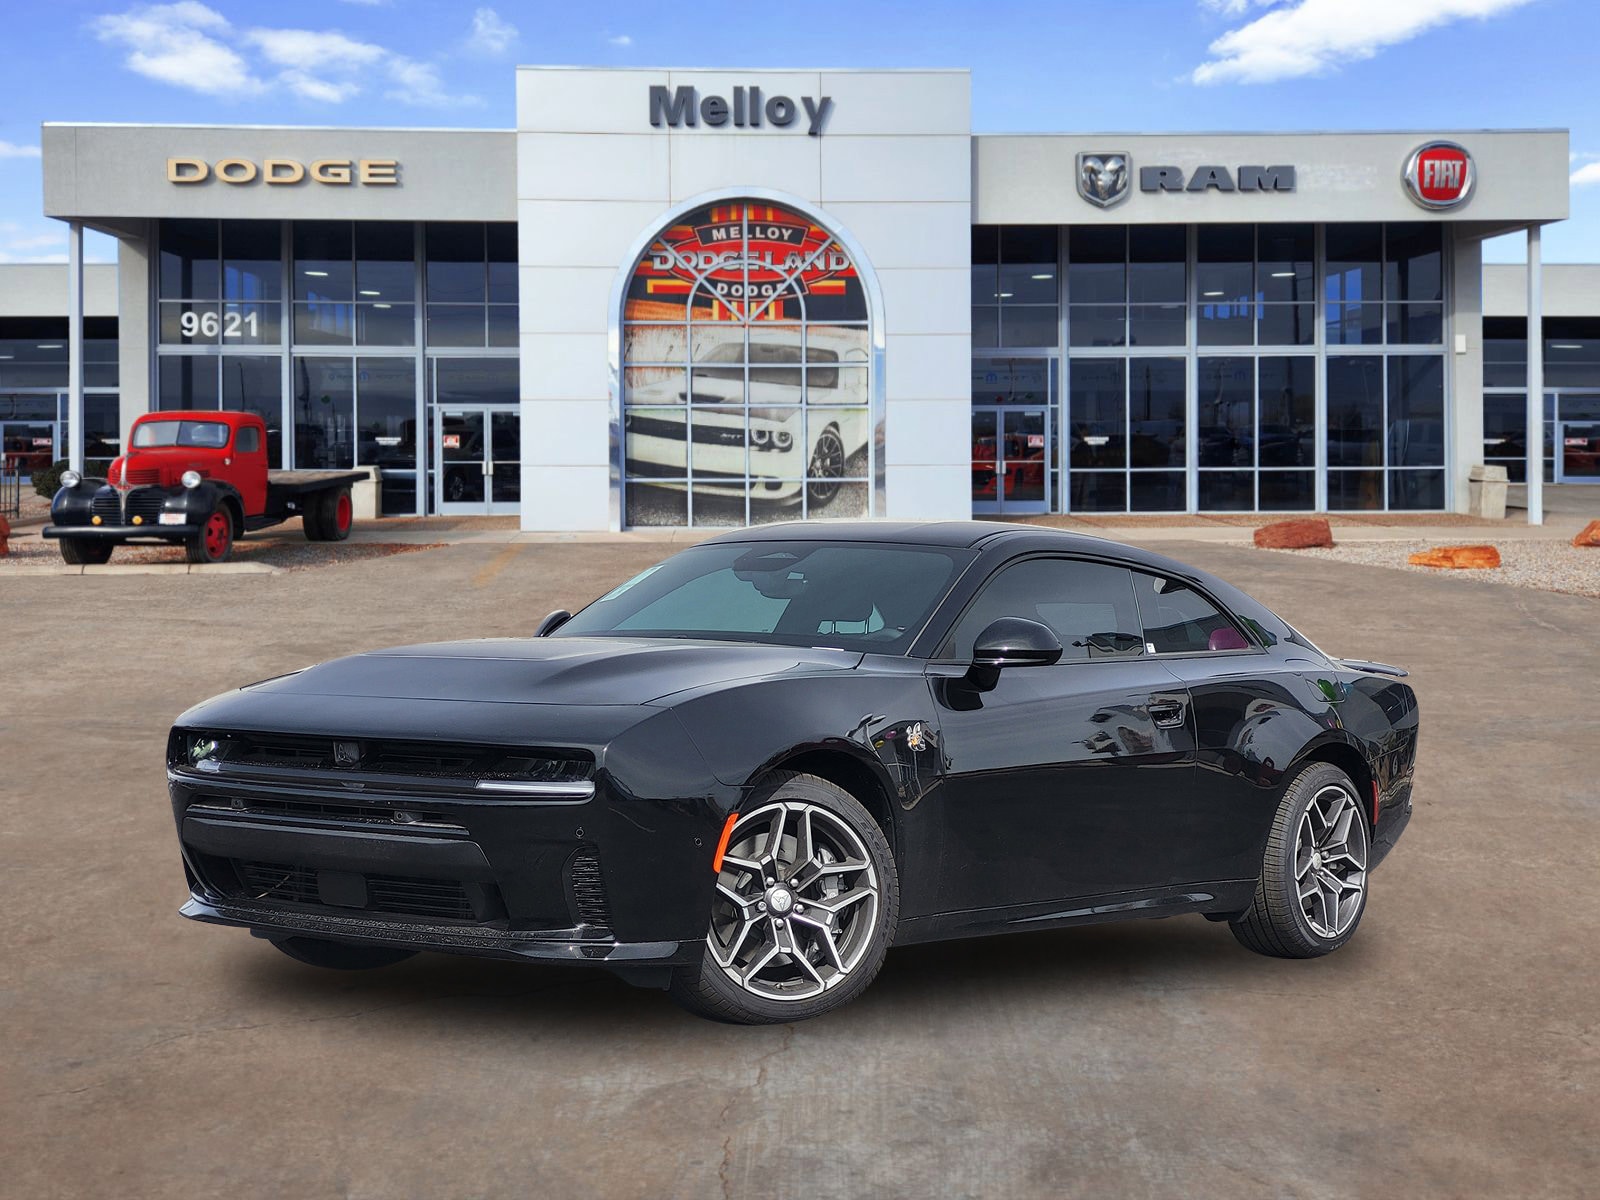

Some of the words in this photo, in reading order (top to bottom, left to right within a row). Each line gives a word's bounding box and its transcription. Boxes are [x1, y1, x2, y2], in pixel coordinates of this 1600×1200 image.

[649, 85, 832, 136] Melloy
[167, 158, 398, 184] DODGE
[1140, 165, 1297, 192] RAM
[1423, 159, 1463, 189] FIAT
[712, 226, 793, 241] MELOY
[181, 311, 258, 337] 9621
